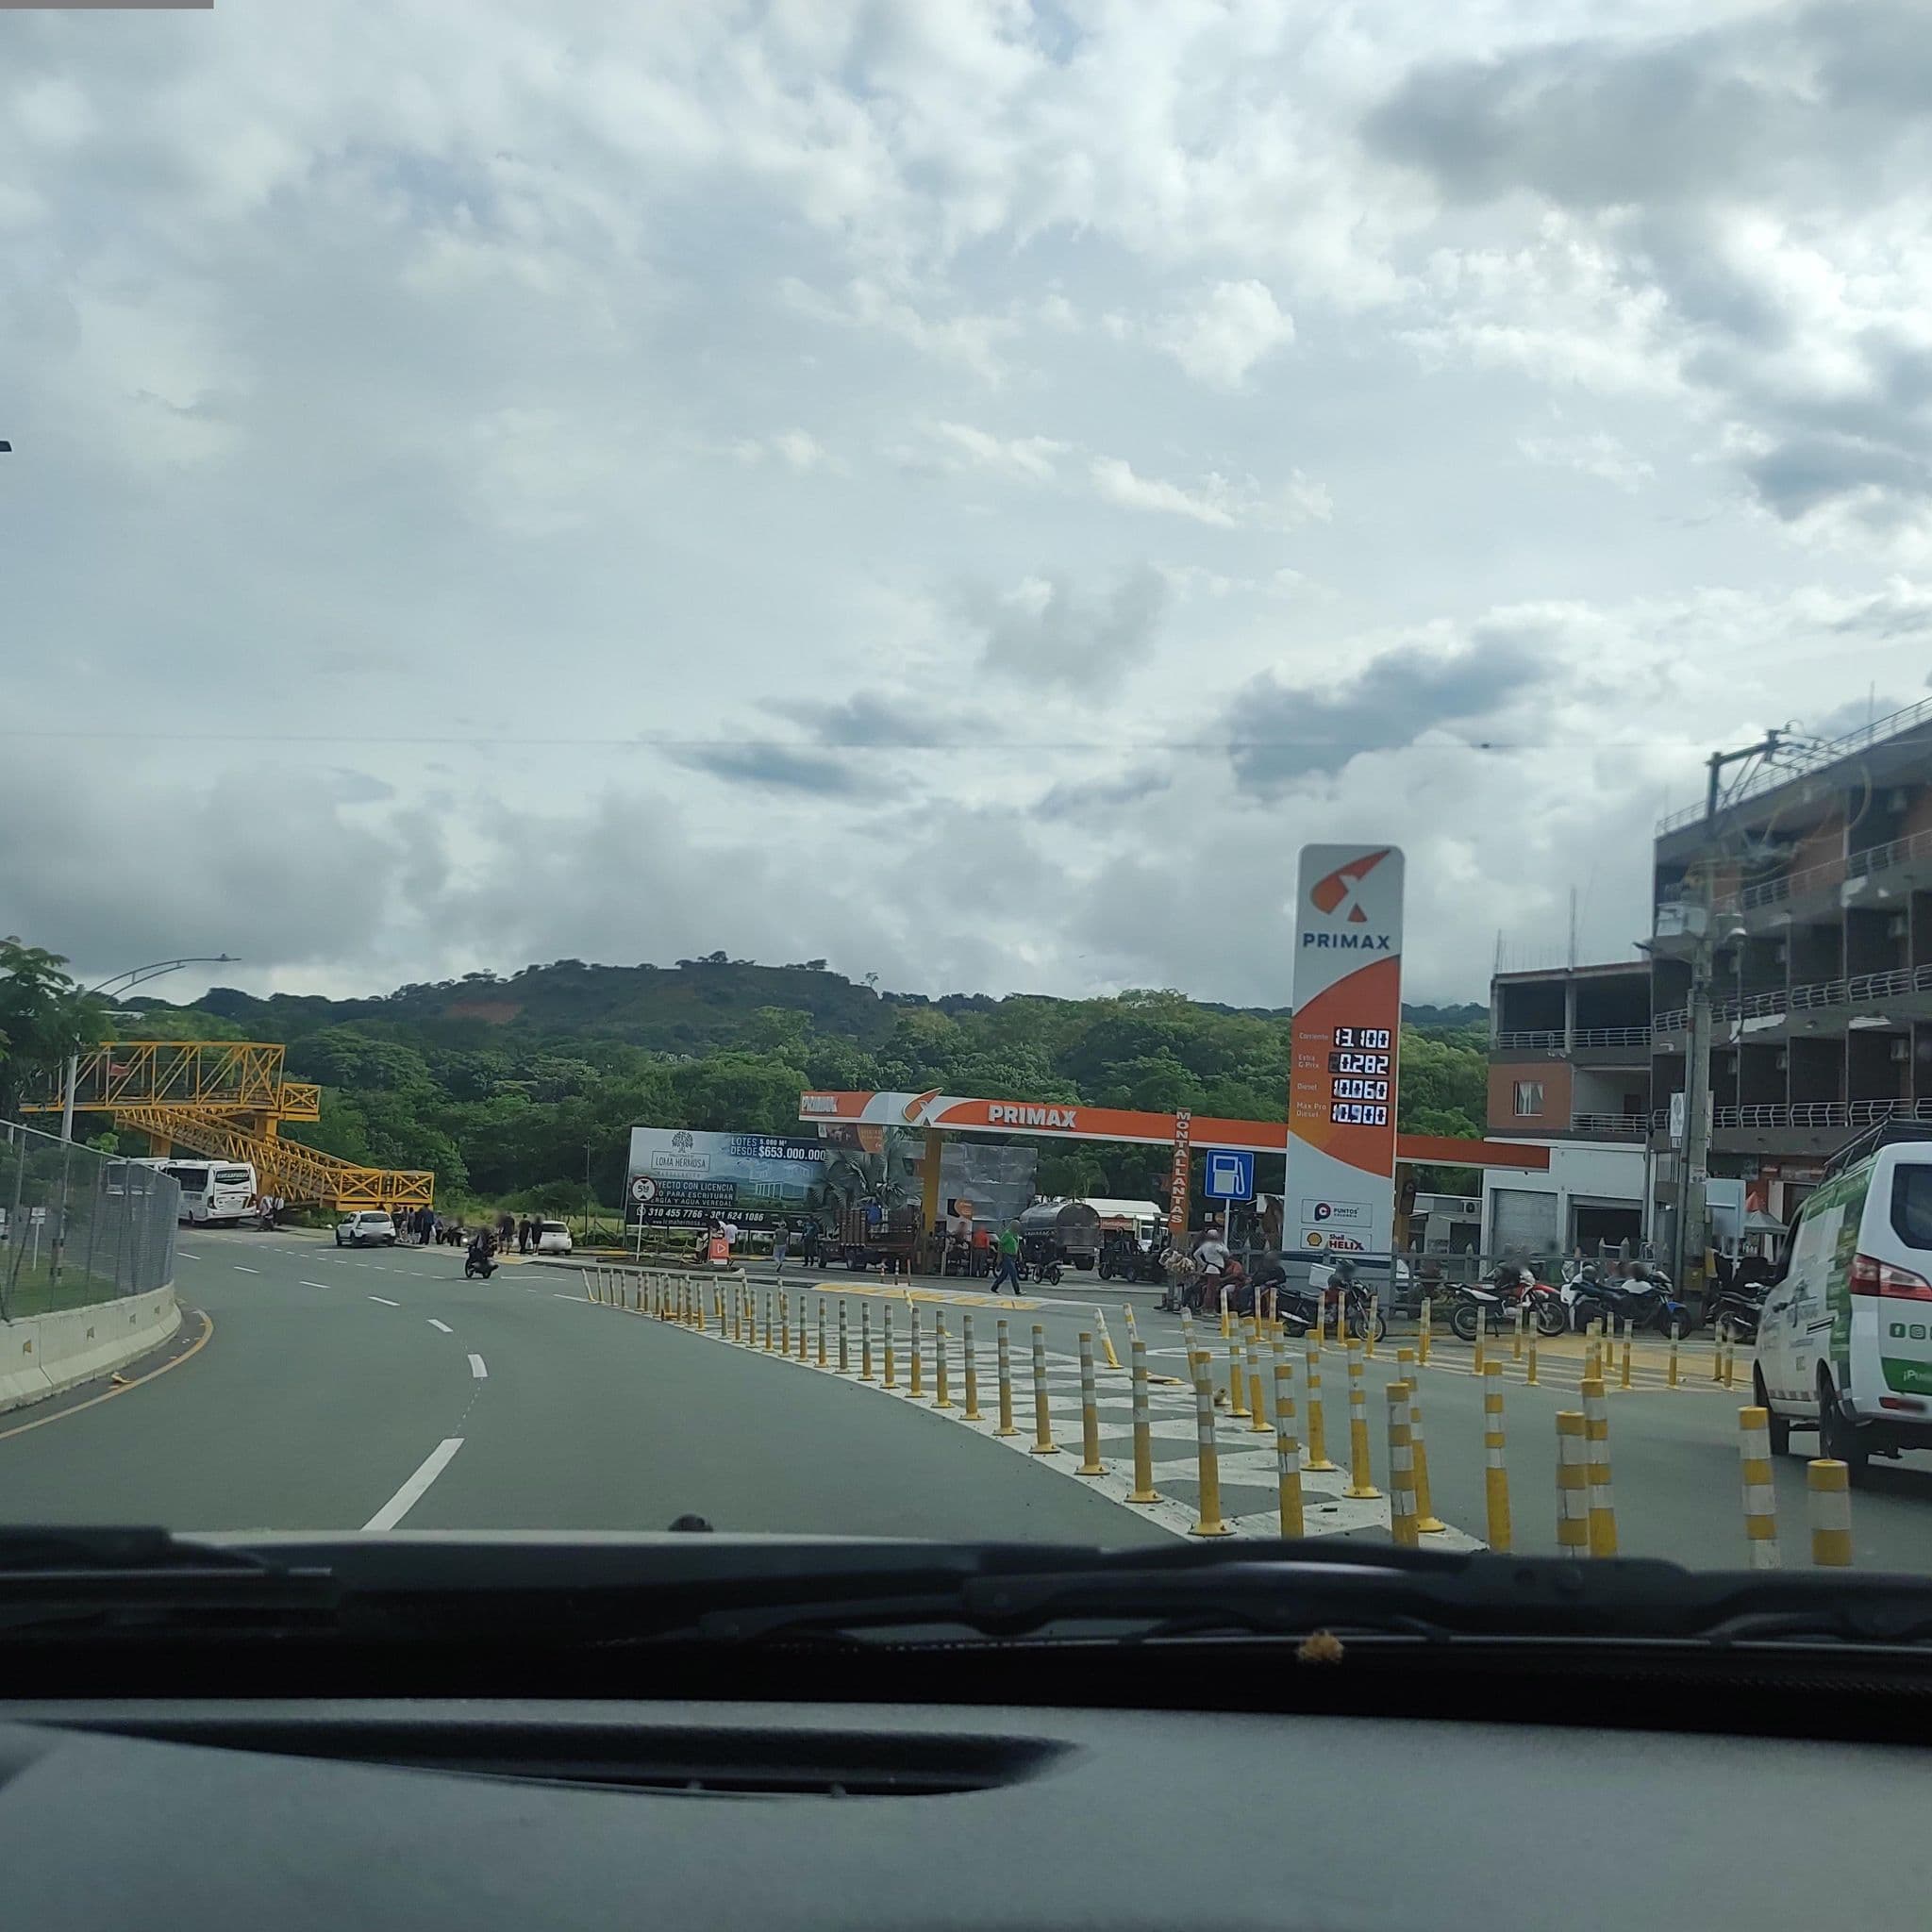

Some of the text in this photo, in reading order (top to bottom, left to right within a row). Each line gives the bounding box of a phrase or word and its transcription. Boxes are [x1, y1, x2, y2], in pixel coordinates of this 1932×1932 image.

[1303, 933, 1390, 949] PRIMAX
[1297, 1082, 1318, 1091] Diesel
[988, 1104, 1076, 1128] PRIMAX
[731, 1137, 758, 1147] LOTES
[730, 1145, 825, 1161] DESDE $653.000.000
[656, 1157, 706, 1169] LOMA HERMOSA
[1170, 1112, 1191, 1224] MONTALLANTAS
[683, 1181, 698, 1190] CON
[700, 1182, 734, 1192] LICENCIA
[688, 1192, 733, 1201] ESCRITURAR
[702, 1199, 732, 1208] VEREDAL
[647, 1208, 664, 1217] 310
[665, 1208, 681, 1218] 455
[683, 1209, 703, 1219] 7766
[1328, 1238, 1365, 1251] HELIX
